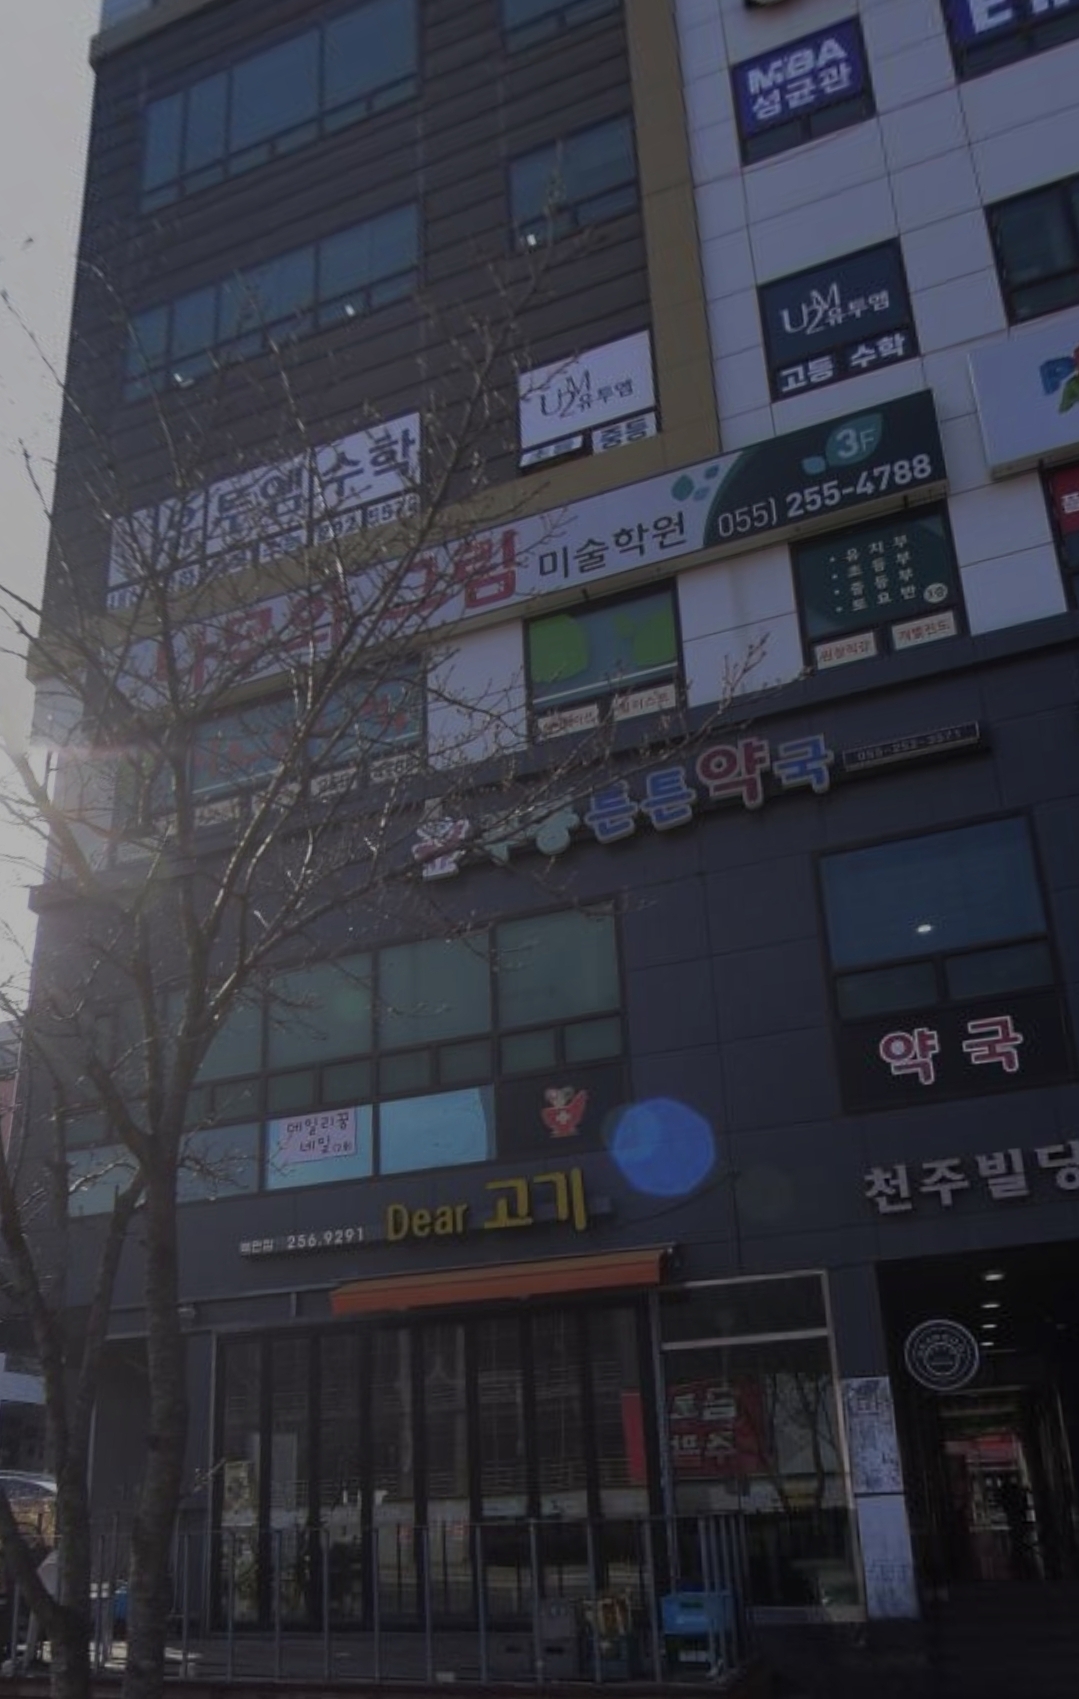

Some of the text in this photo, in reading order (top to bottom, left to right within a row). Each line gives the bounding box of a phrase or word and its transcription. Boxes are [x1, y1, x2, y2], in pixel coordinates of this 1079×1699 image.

[748, 37, 848, 95] MBA
[751, 63, 852, 120] 성균관
[829, 289, 891, 327] 유투엠
[779, 333, 906, 394] 고등 수학
[578, 380, 633, 410] 유투엠
[599, 417, 648, 449] 중등
[836, 427, 877, 460] 3F
[718, 454, 932, 537] 055) 255-4788
[539, 512, 687, 578] 미술학원
[584, 732, 834, 844] 튼튼약국
[388, 1167, 586, 1242] Dear 고기
[287, 1227, 364, 1250] 256.9291
